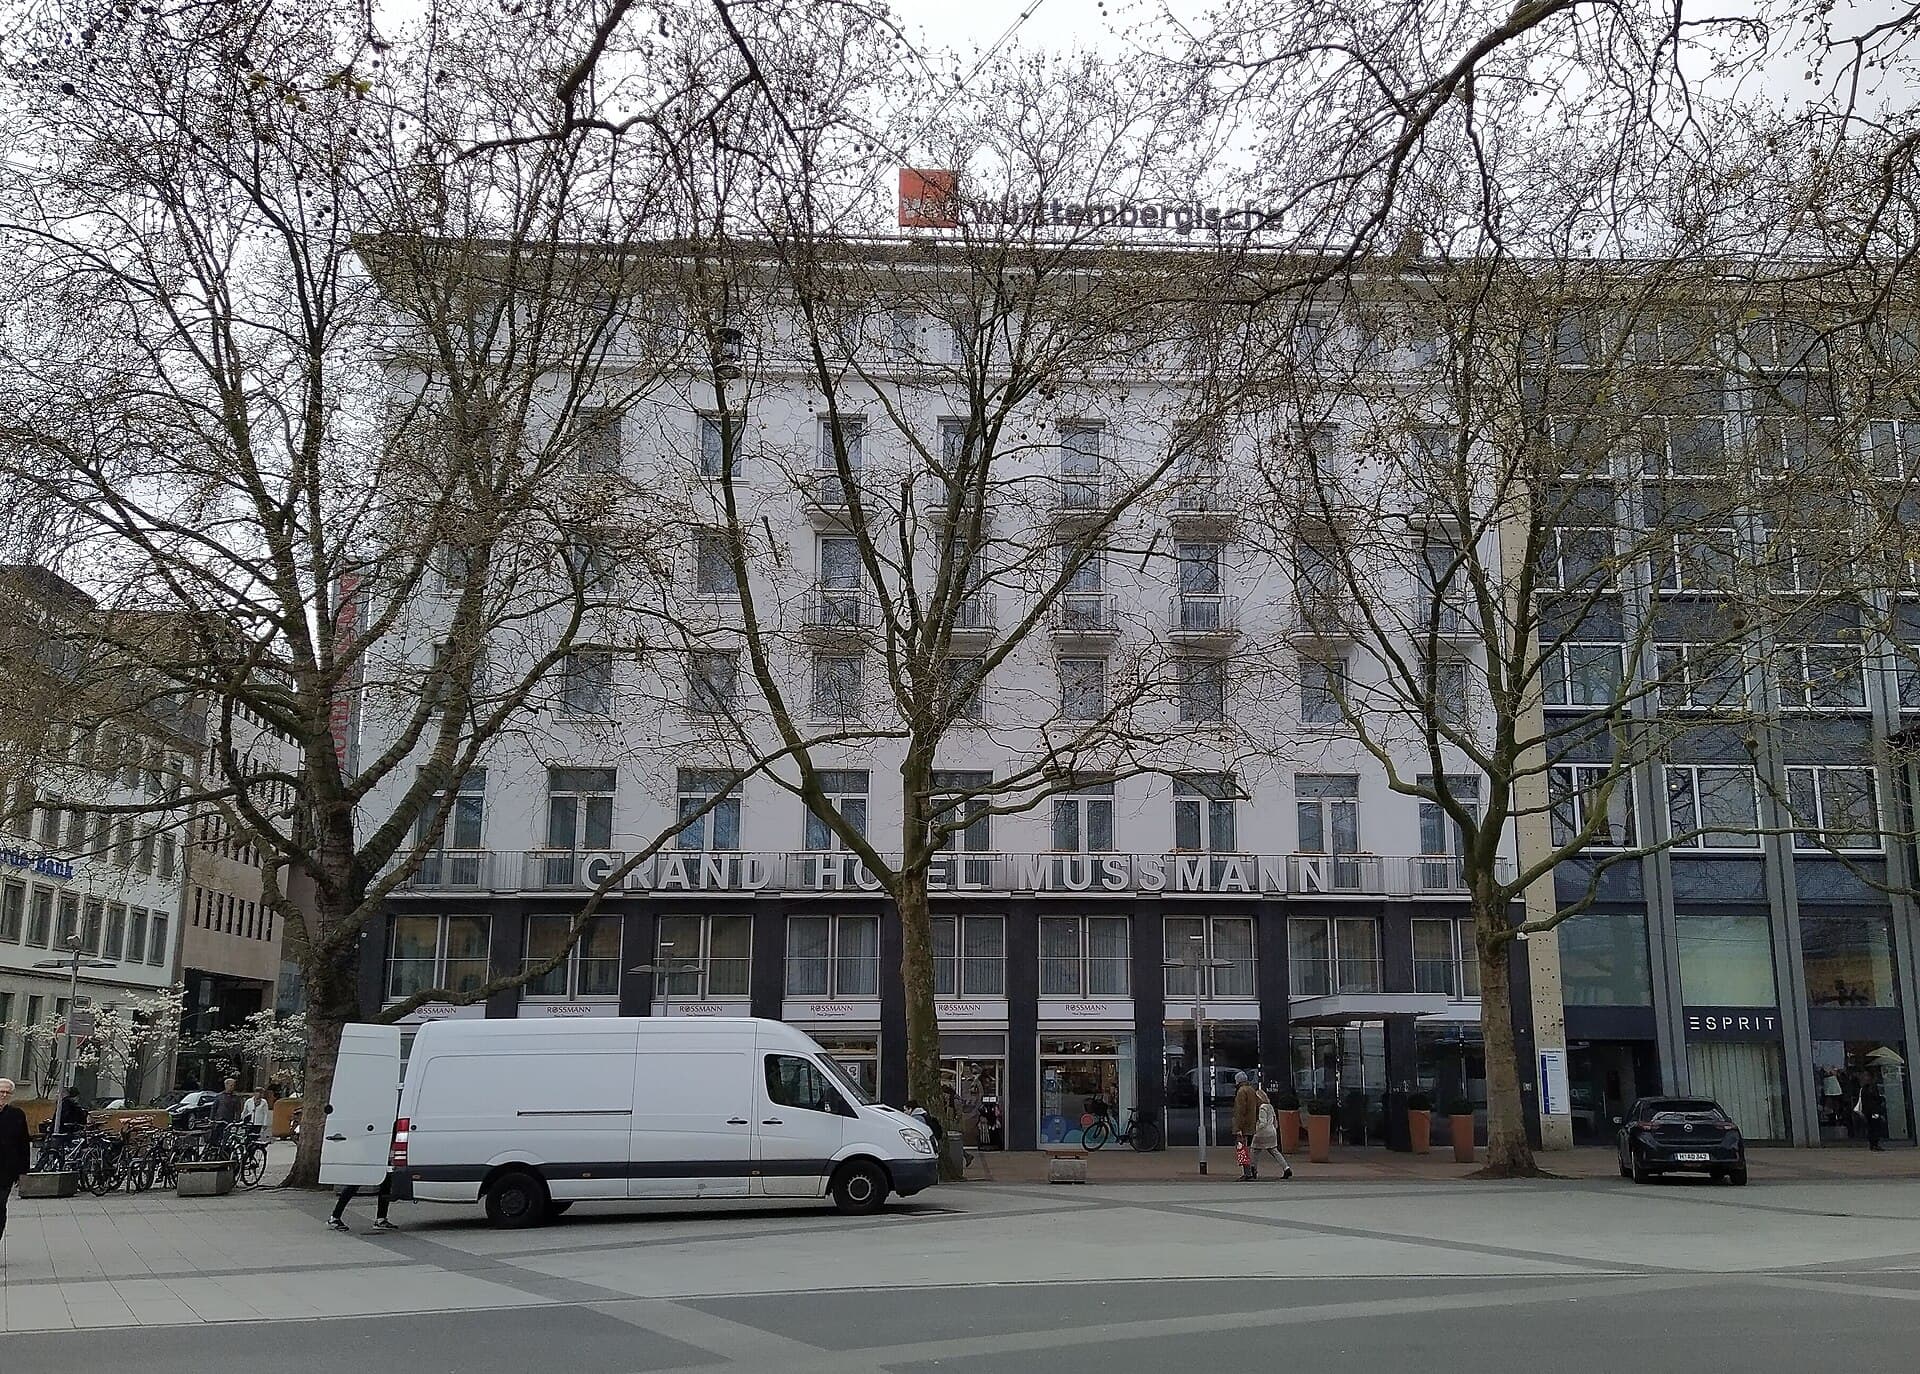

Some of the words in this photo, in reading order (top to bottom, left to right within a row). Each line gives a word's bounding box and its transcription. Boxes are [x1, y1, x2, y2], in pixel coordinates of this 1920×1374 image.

[581, 853, 771, 891] GRAND
[816, 854, 981, 891] HOEL
[1018, 855, 1328, 892] MUSSMANN
[1689, 1016, 1774, 1030] ESPRIT
